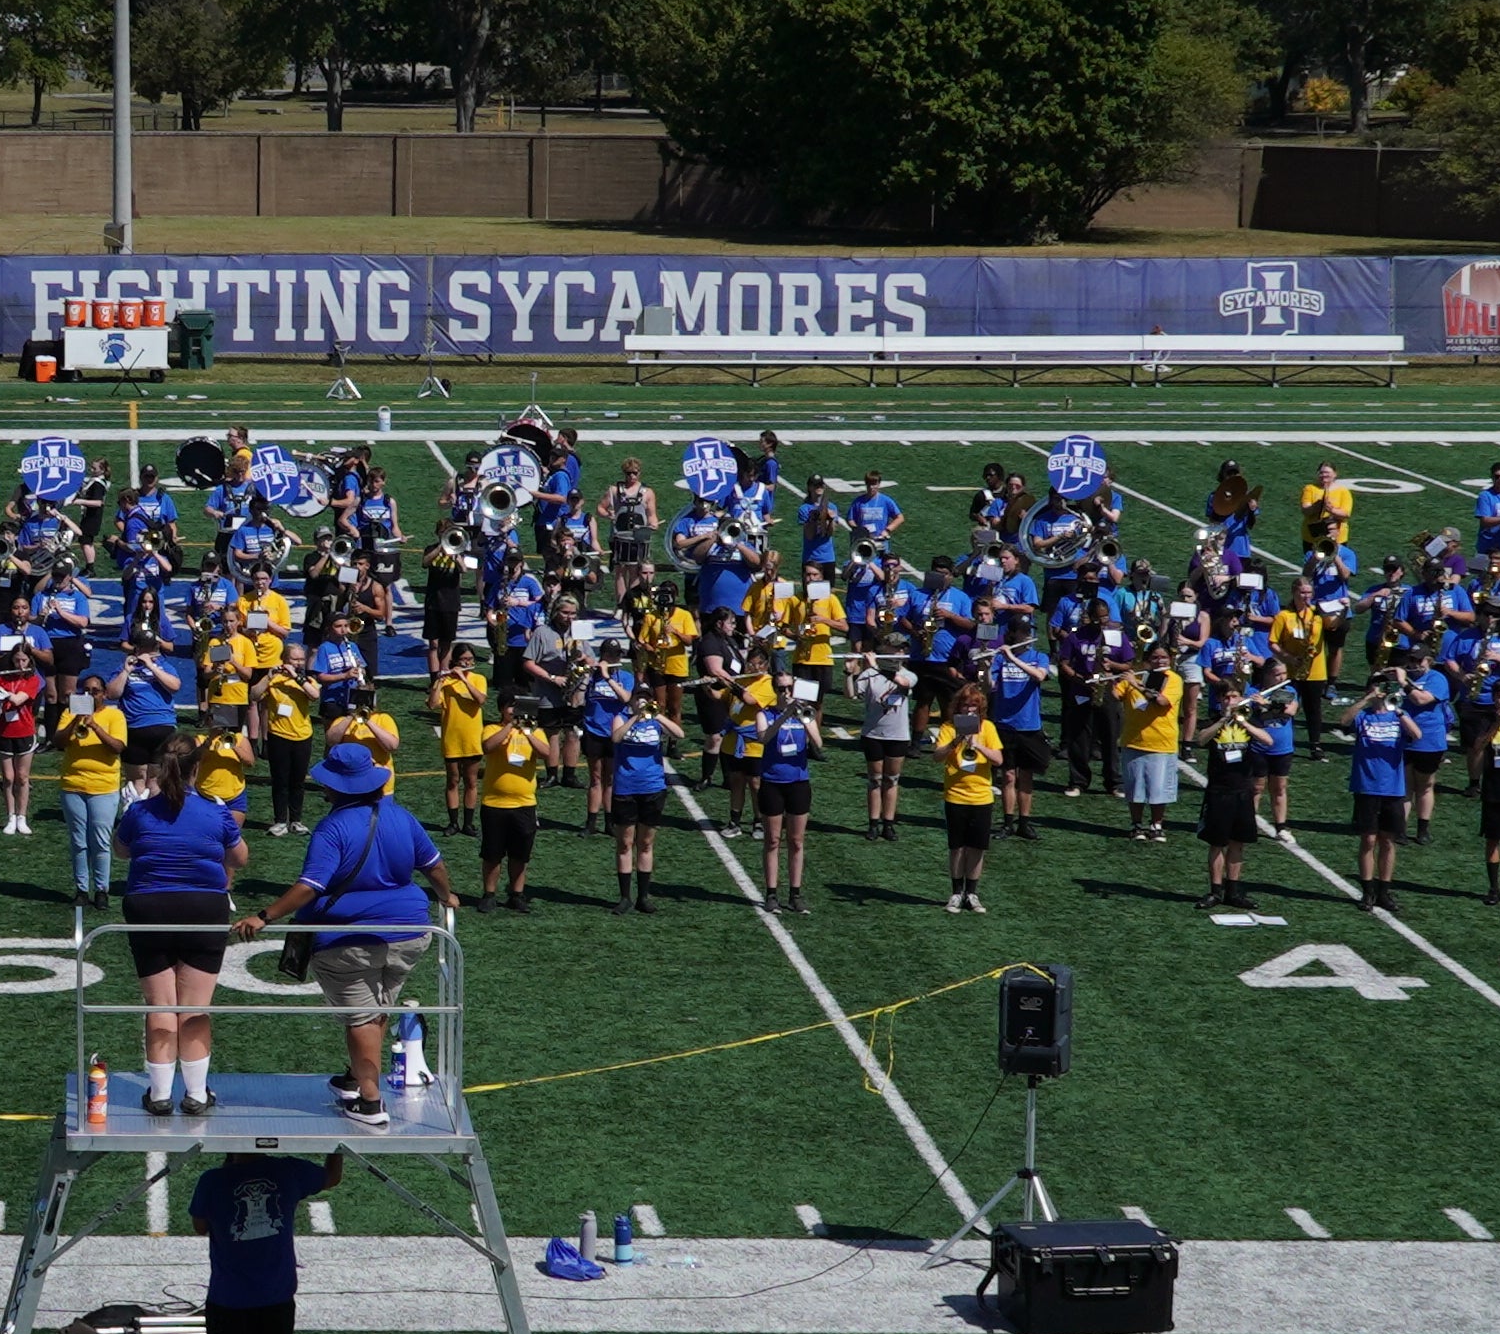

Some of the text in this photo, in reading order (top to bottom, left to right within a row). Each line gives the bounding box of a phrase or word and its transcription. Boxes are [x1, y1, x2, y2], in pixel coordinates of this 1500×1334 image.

[447, 270, 927, 343] SYCAMORES
[1223, 291, 1322, 312] SYCAMORES
[24, 457, 83, 471] SYCAMORES
[1051, 456, 1104, 472] SYCAMORES
[485, 466, 535, 479] SYCAMORES
